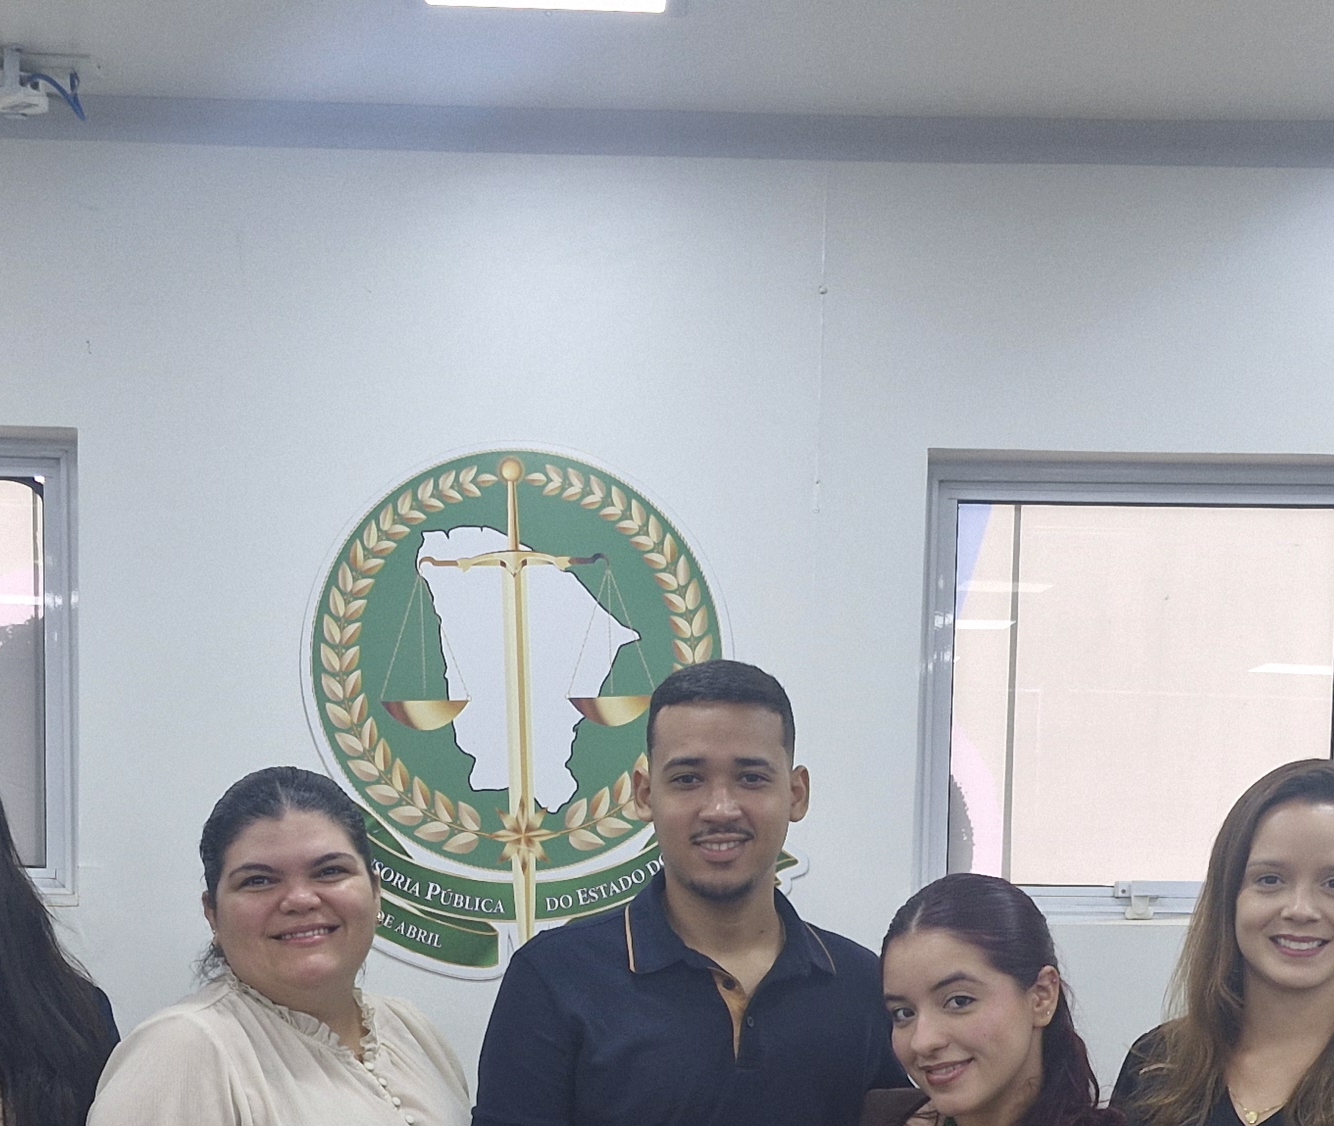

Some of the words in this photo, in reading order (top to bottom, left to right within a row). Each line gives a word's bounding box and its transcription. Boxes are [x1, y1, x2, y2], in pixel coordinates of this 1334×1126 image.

[425, 881, 505, 914] PÚBLICA
[546, 894, 573, 912] DO
[395, 921, 442, 948] ABRIL
